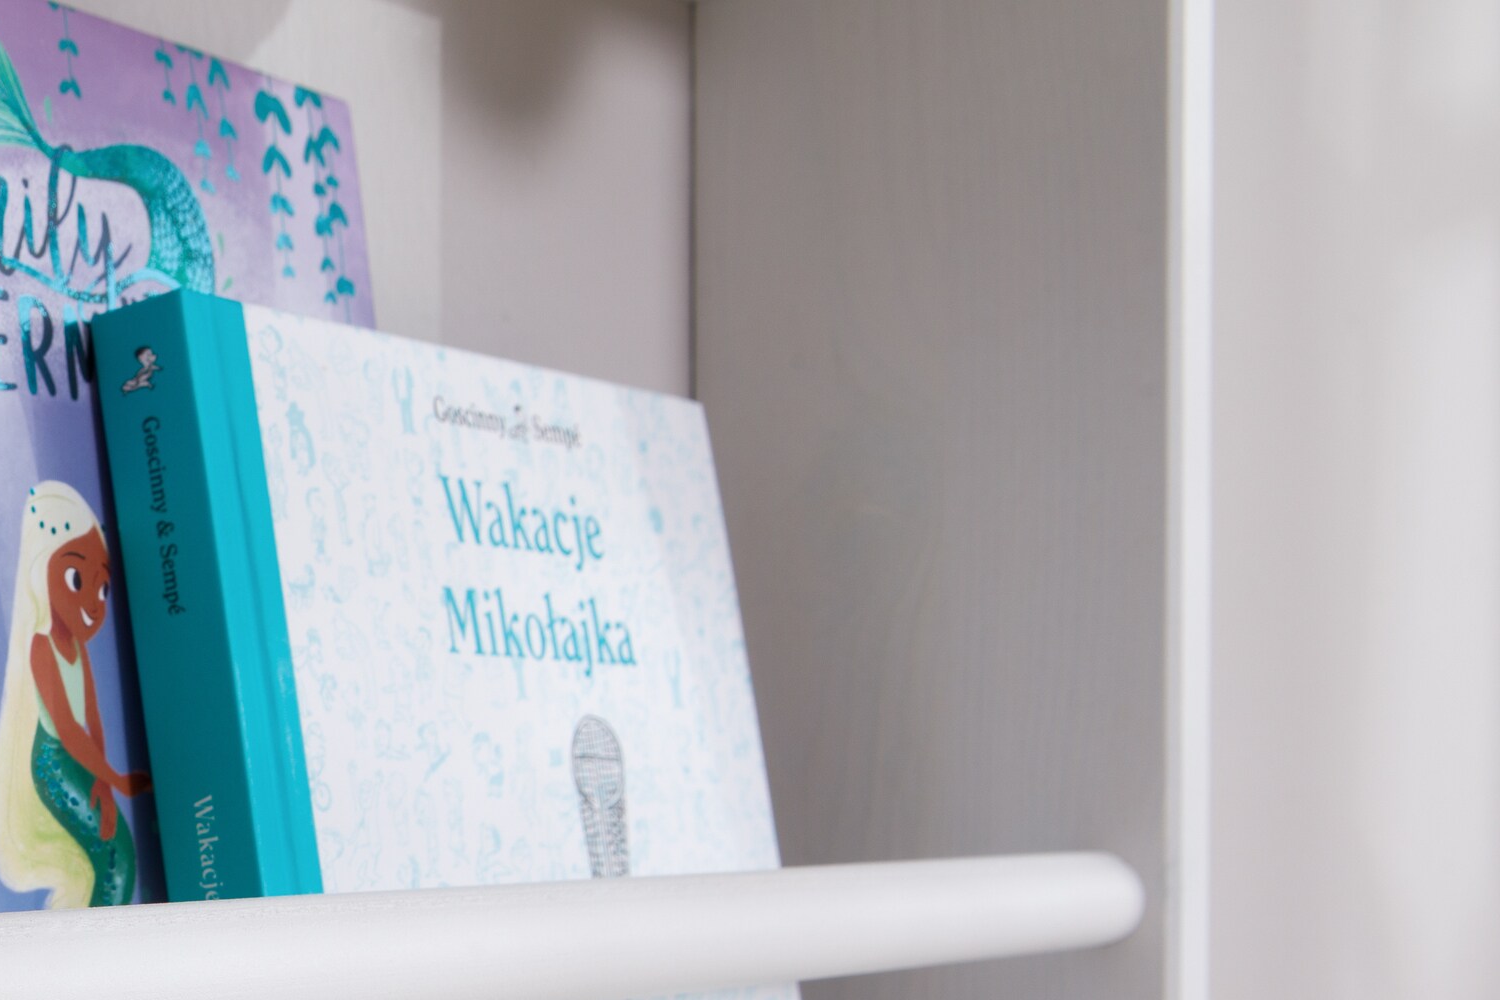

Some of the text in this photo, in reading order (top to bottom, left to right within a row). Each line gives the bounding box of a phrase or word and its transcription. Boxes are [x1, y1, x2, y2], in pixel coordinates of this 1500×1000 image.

[141, 416, 186, 616] Goscinny & Sempé
[438, 475, 603, 571] Wakacje
[442, 586, 637, 677] Mikołajka
[194, 794, 224, 900] Wakacje
